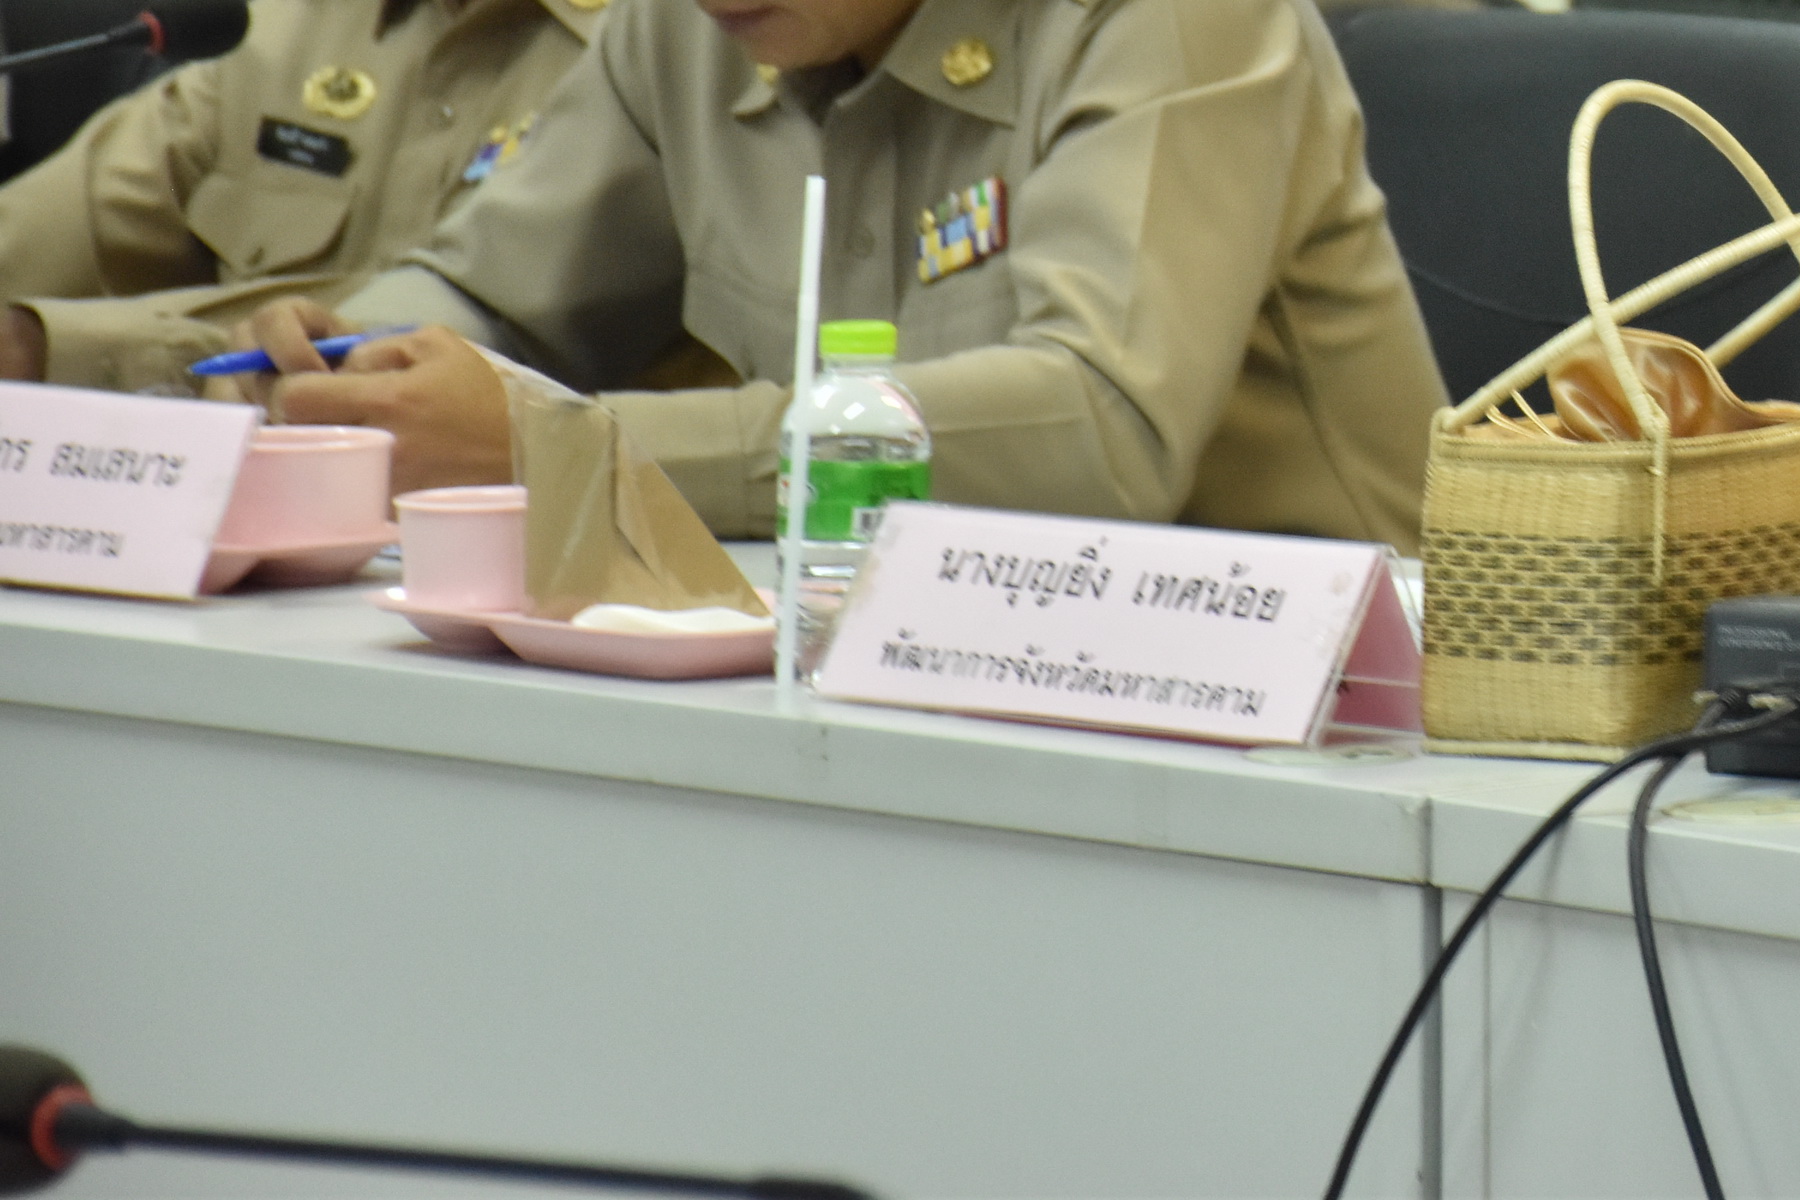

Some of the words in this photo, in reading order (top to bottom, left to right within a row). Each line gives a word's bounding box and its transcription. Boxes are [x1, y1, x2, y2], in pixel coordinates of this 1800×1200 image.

[938, 537, 1112, 608] นางบุญยิ่ง
[1132, 562, 1286, 623] เทศน้อย
[880, 629, 1268, 718] พัฒนาการจังหวัดมหาสารคาม
